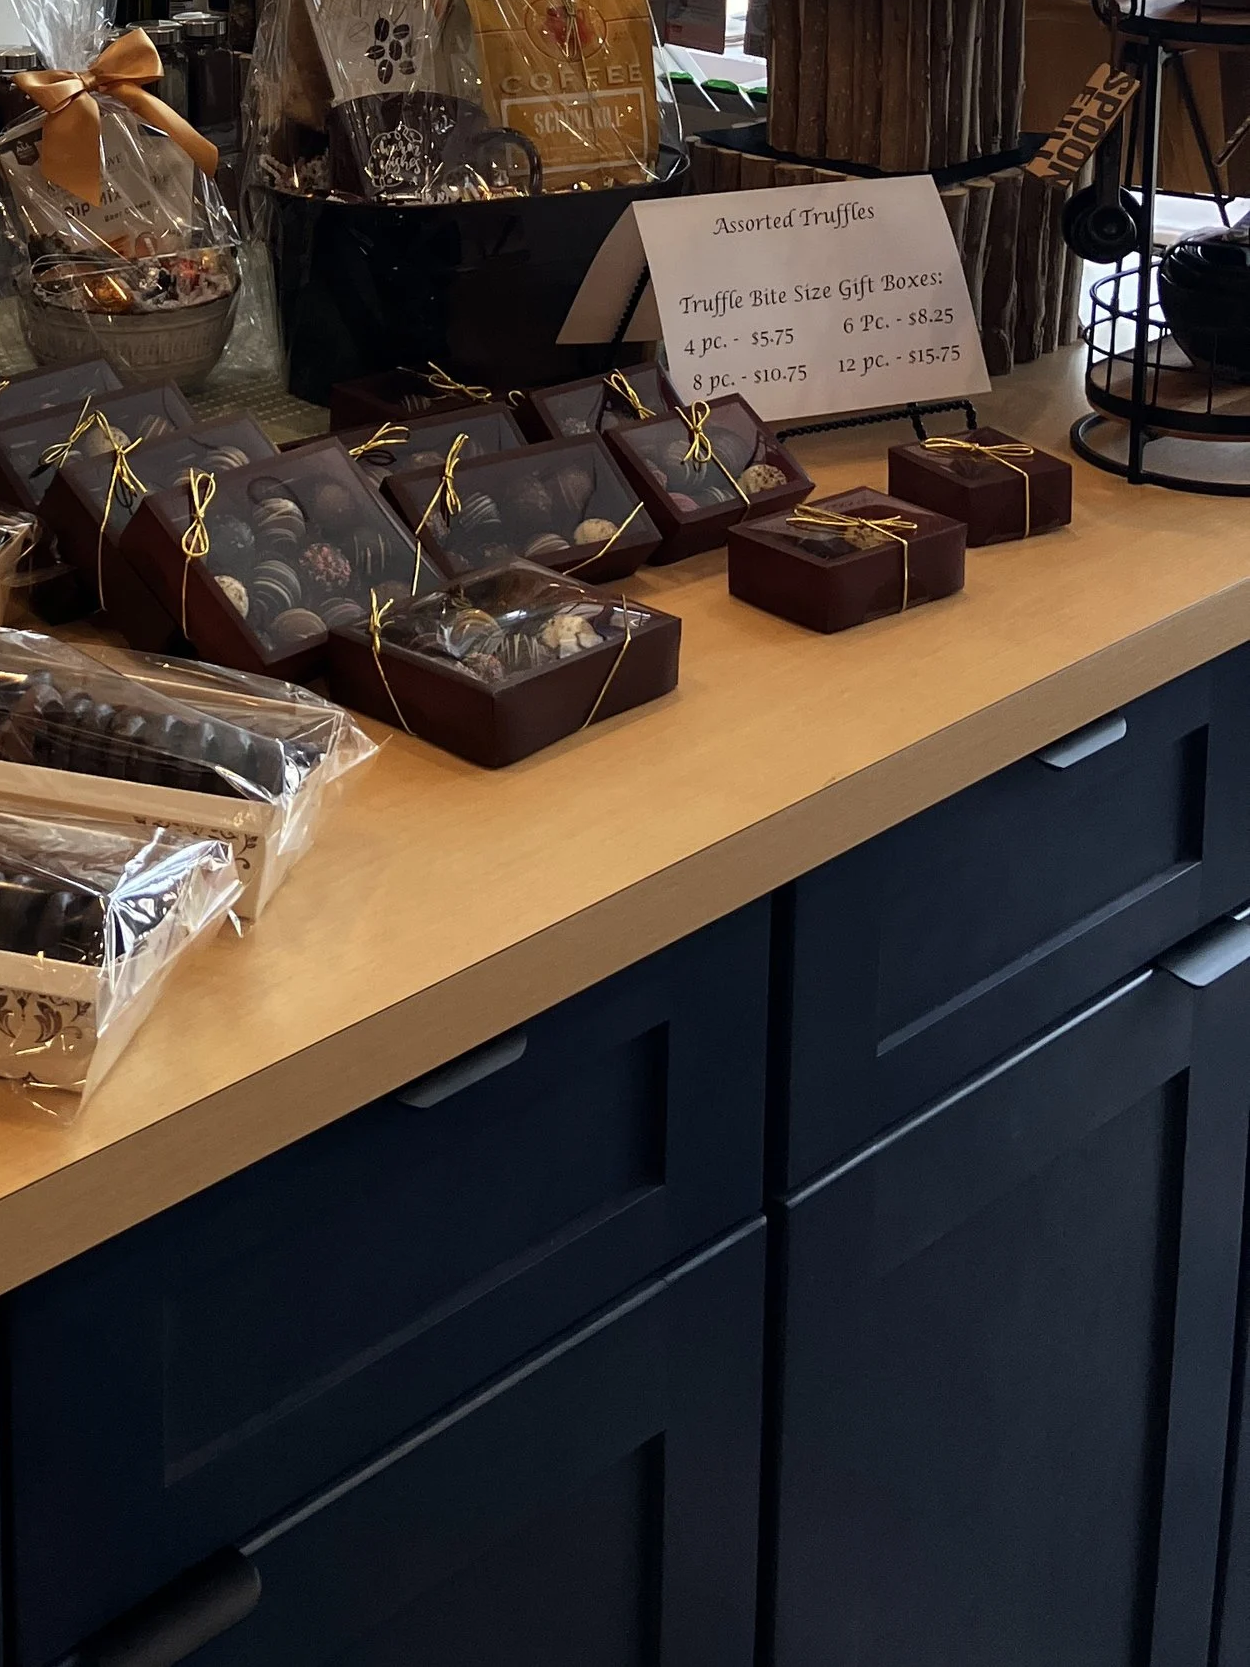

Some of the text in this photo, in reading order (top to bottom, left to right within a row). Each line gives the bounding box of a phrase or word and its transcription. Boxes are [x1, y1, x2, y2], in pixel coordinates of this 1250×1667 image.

[501, 63, 644, 95] COFFEE
[1048, 69, 1136, 188] SPOON
[64, 202, 91, 220] Dip
[712, 201, 875, 236] Assorted Truffles
[679, 270, 944, 318] Truffle Bite Size Gift Boxes:
[843, 316, 854, 334] 6
[861, 313, 890, 332] Pc.
[908, 307, 954, 326] $8.25
[684, 339, 696, 356] 4
[700, 333, 727, 358] pc.
[751, 327, 795, 348] $5.75
[838, 357, 857, 374] 12
[861, 352, 889, 377] pc.
[908, 343, 961, 365] $15.75
[693, 373, 703, 392] 8
[707, 369, 736, 396] pc.
[753, 364, 808, 385] $10.75
